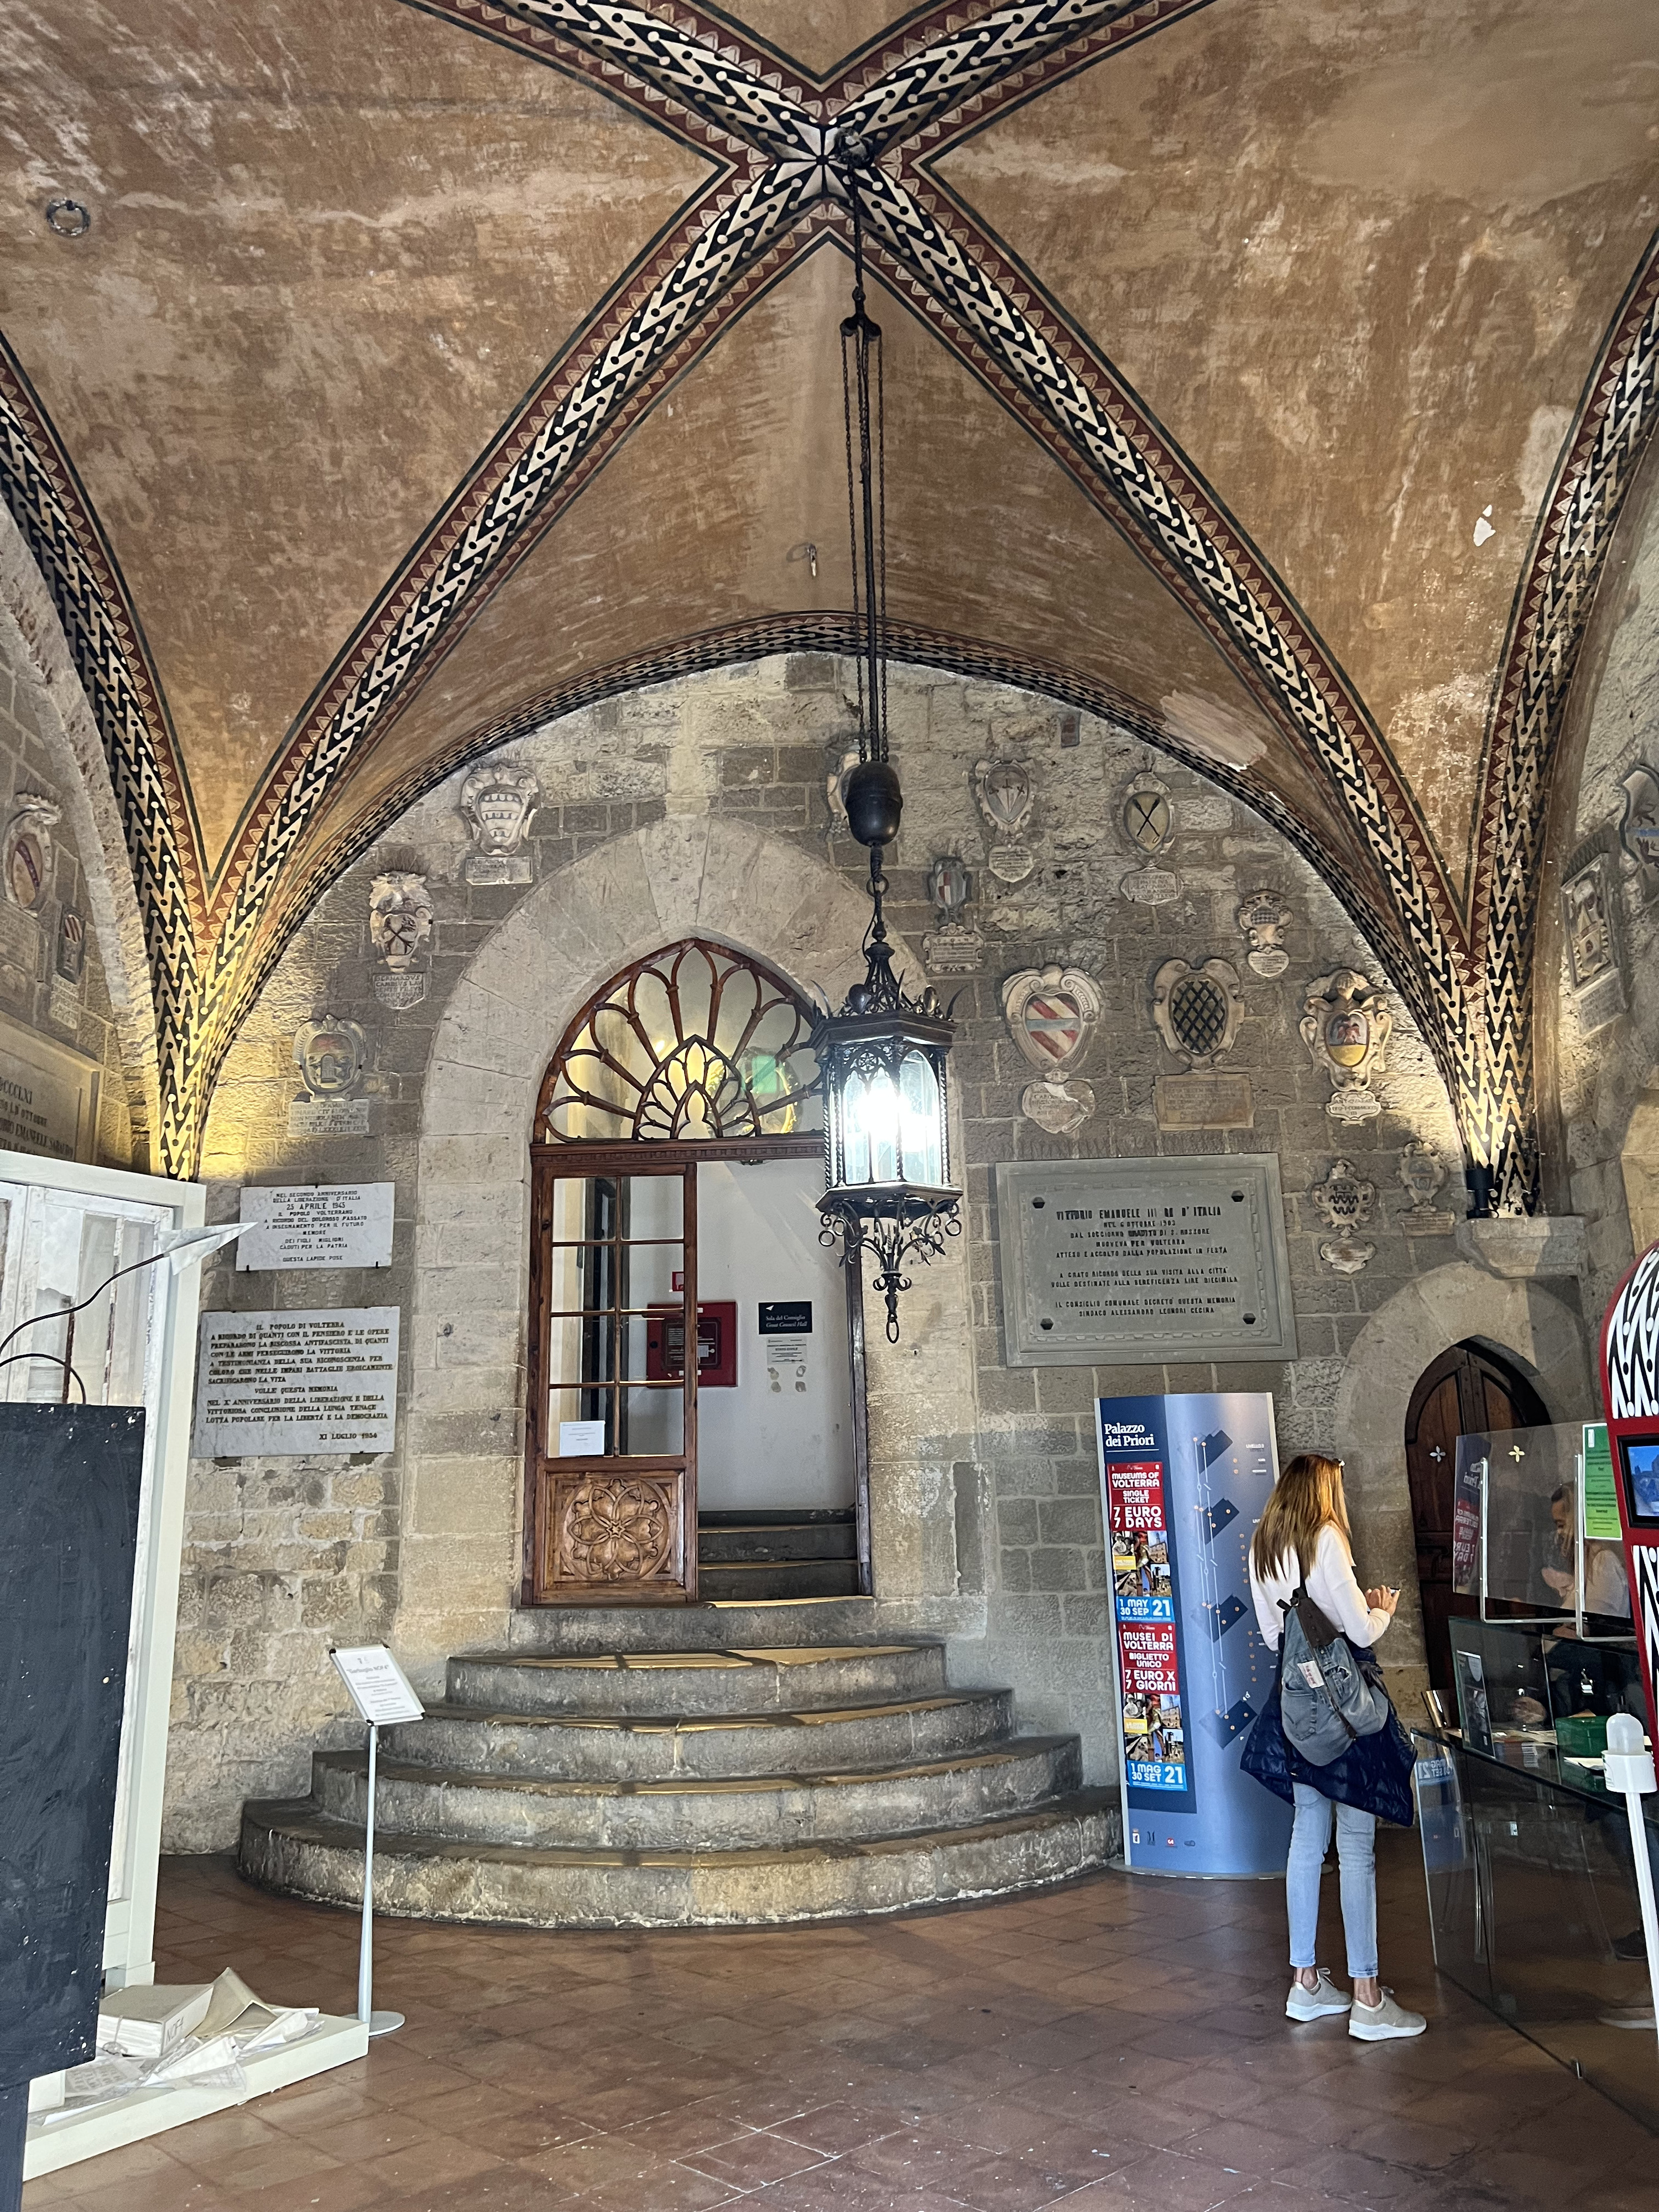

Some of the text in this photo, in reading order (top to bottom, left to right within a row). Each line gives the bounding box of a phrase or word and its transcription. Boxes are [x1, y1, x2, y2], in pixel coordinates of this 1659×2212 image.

[1057, 1211, 1092, 1220] VITTORIO
[1099, 1209, 1140, 1219] EMANUELE
[1147, 1208, 1157, 1217] III
[1194, 1207, 1221, 1216] ITALIA
[1104, 1422, 1145, 1434] Palazzo
[1105, 1434, 1155, 1447] dei Priori
[1112, 1479, 1160, 1488] VOLTERRA
[1113, 1506, 1161, 1517] 7 EURO
[1114, 1517, 1162, 1528] 7 DAYS
[1120, 1599, 1171, 1616] 1 MAY 21
[1120, 1607, 1149, 1616] 30 SEP
[1123, 1632, 1173, 1641] MUSEI DI
[1124, 1641, 1173, 1650] VOLTERRA
[1129, 1652, 1169, 1661] BIGLIETTO
[1125, 1670, 1175, 1681] 7 EURO X
[1125, 1679, 1176, 1691] 7 GIORNI
[1130, 1763, 1183, 1783] 1 MAG 21
[1132, 1772, 1161, 1782] 30 SET
